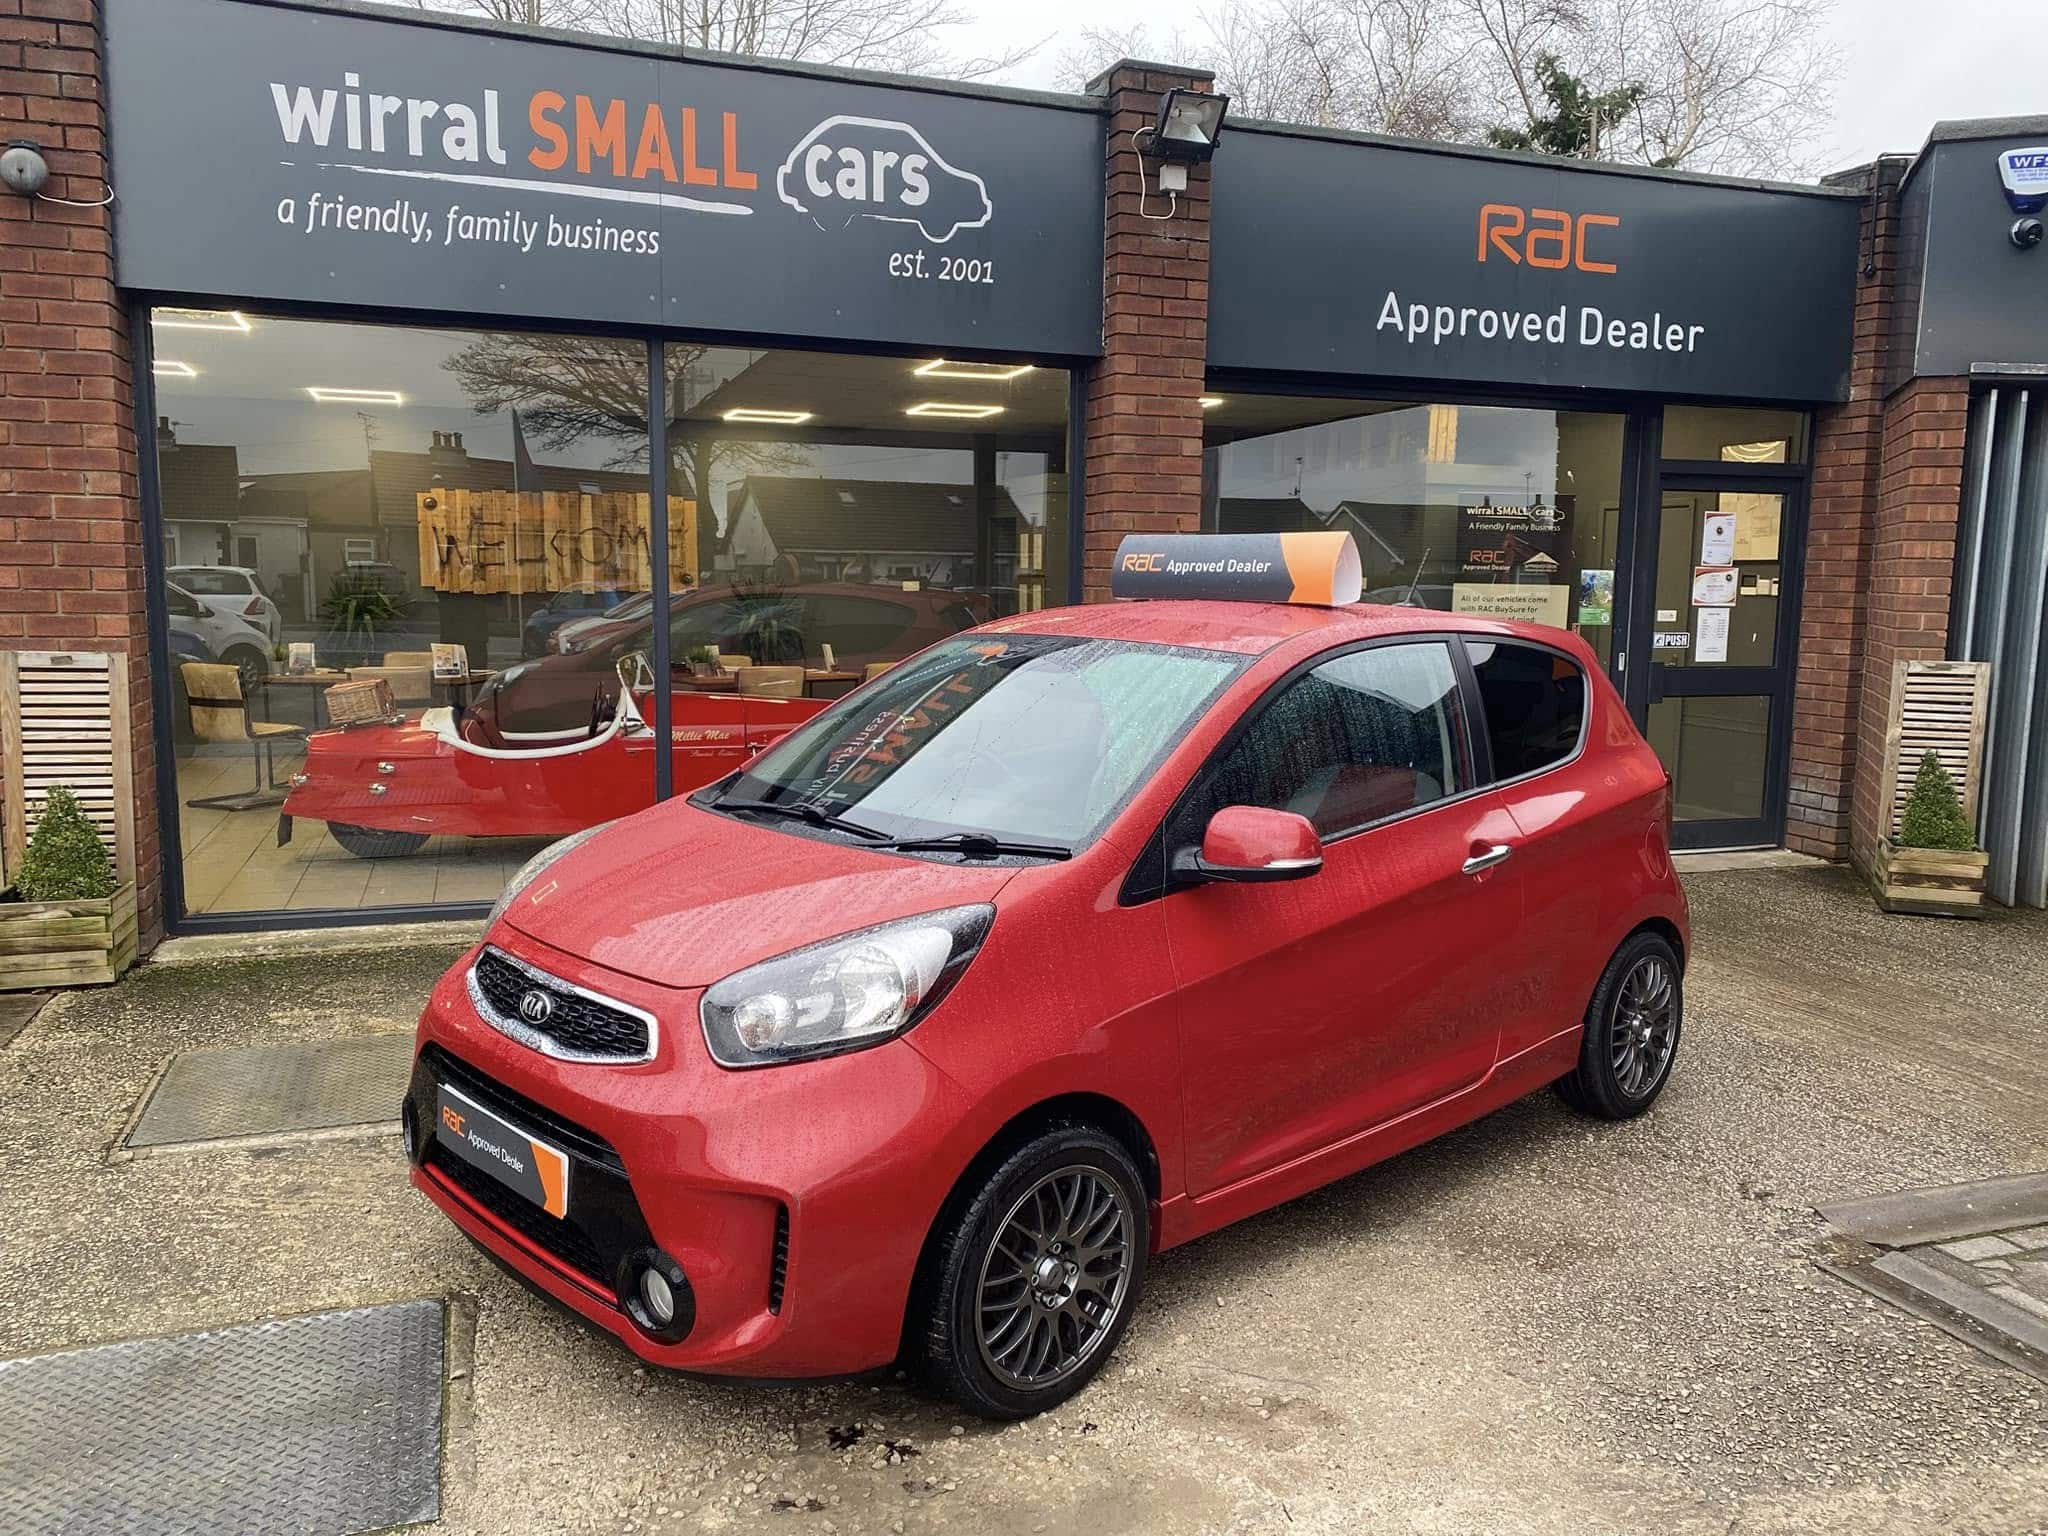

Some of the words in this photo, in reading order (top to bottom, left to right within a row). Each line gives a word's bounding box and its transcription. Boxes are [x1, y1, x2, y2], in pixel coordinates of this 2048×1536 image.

[269, 71, 507, 165] wirral
[527, 90, 758, 190] SMALL
[804, 142, 931, 207] cars
[277, 198, 296, 225] a
[306, 195, 433, 244] friendly,
[444, 206, 538, 254] family
[546, 213, 660, 256] business
[888, 248, 930, 280] est.
[938, 254, 995, 284] 2001
[1376, 290, 1567, 346] Approved
[1579, 307, 1705, 352] Dealer
[1467, 505, 1494, 515] wirral
[1496, 506, 1528, 516] SMALL
[1535, 509, 1555, 517] cars
[1476, 522, 1505, 532] Friendly
[1506, 523, 1530, 533] Family
[1166, 559, 1223, 576] Approved
[1227, 559, 1271, 574] Dealer
[1462, 564, 1491, 573] Approved
[1497, 595, 1526, 603] vehicles
[1495, 605, 1525, 614] BuySure
[1527, 605, 1538, 613] for
[1665, 634, 1688, 646] PUSH
[520, 996, 544, 1019] KIA
[467, 1129, 501, 1159] Approved
[501, 1148, 524, 1174] Dealer
